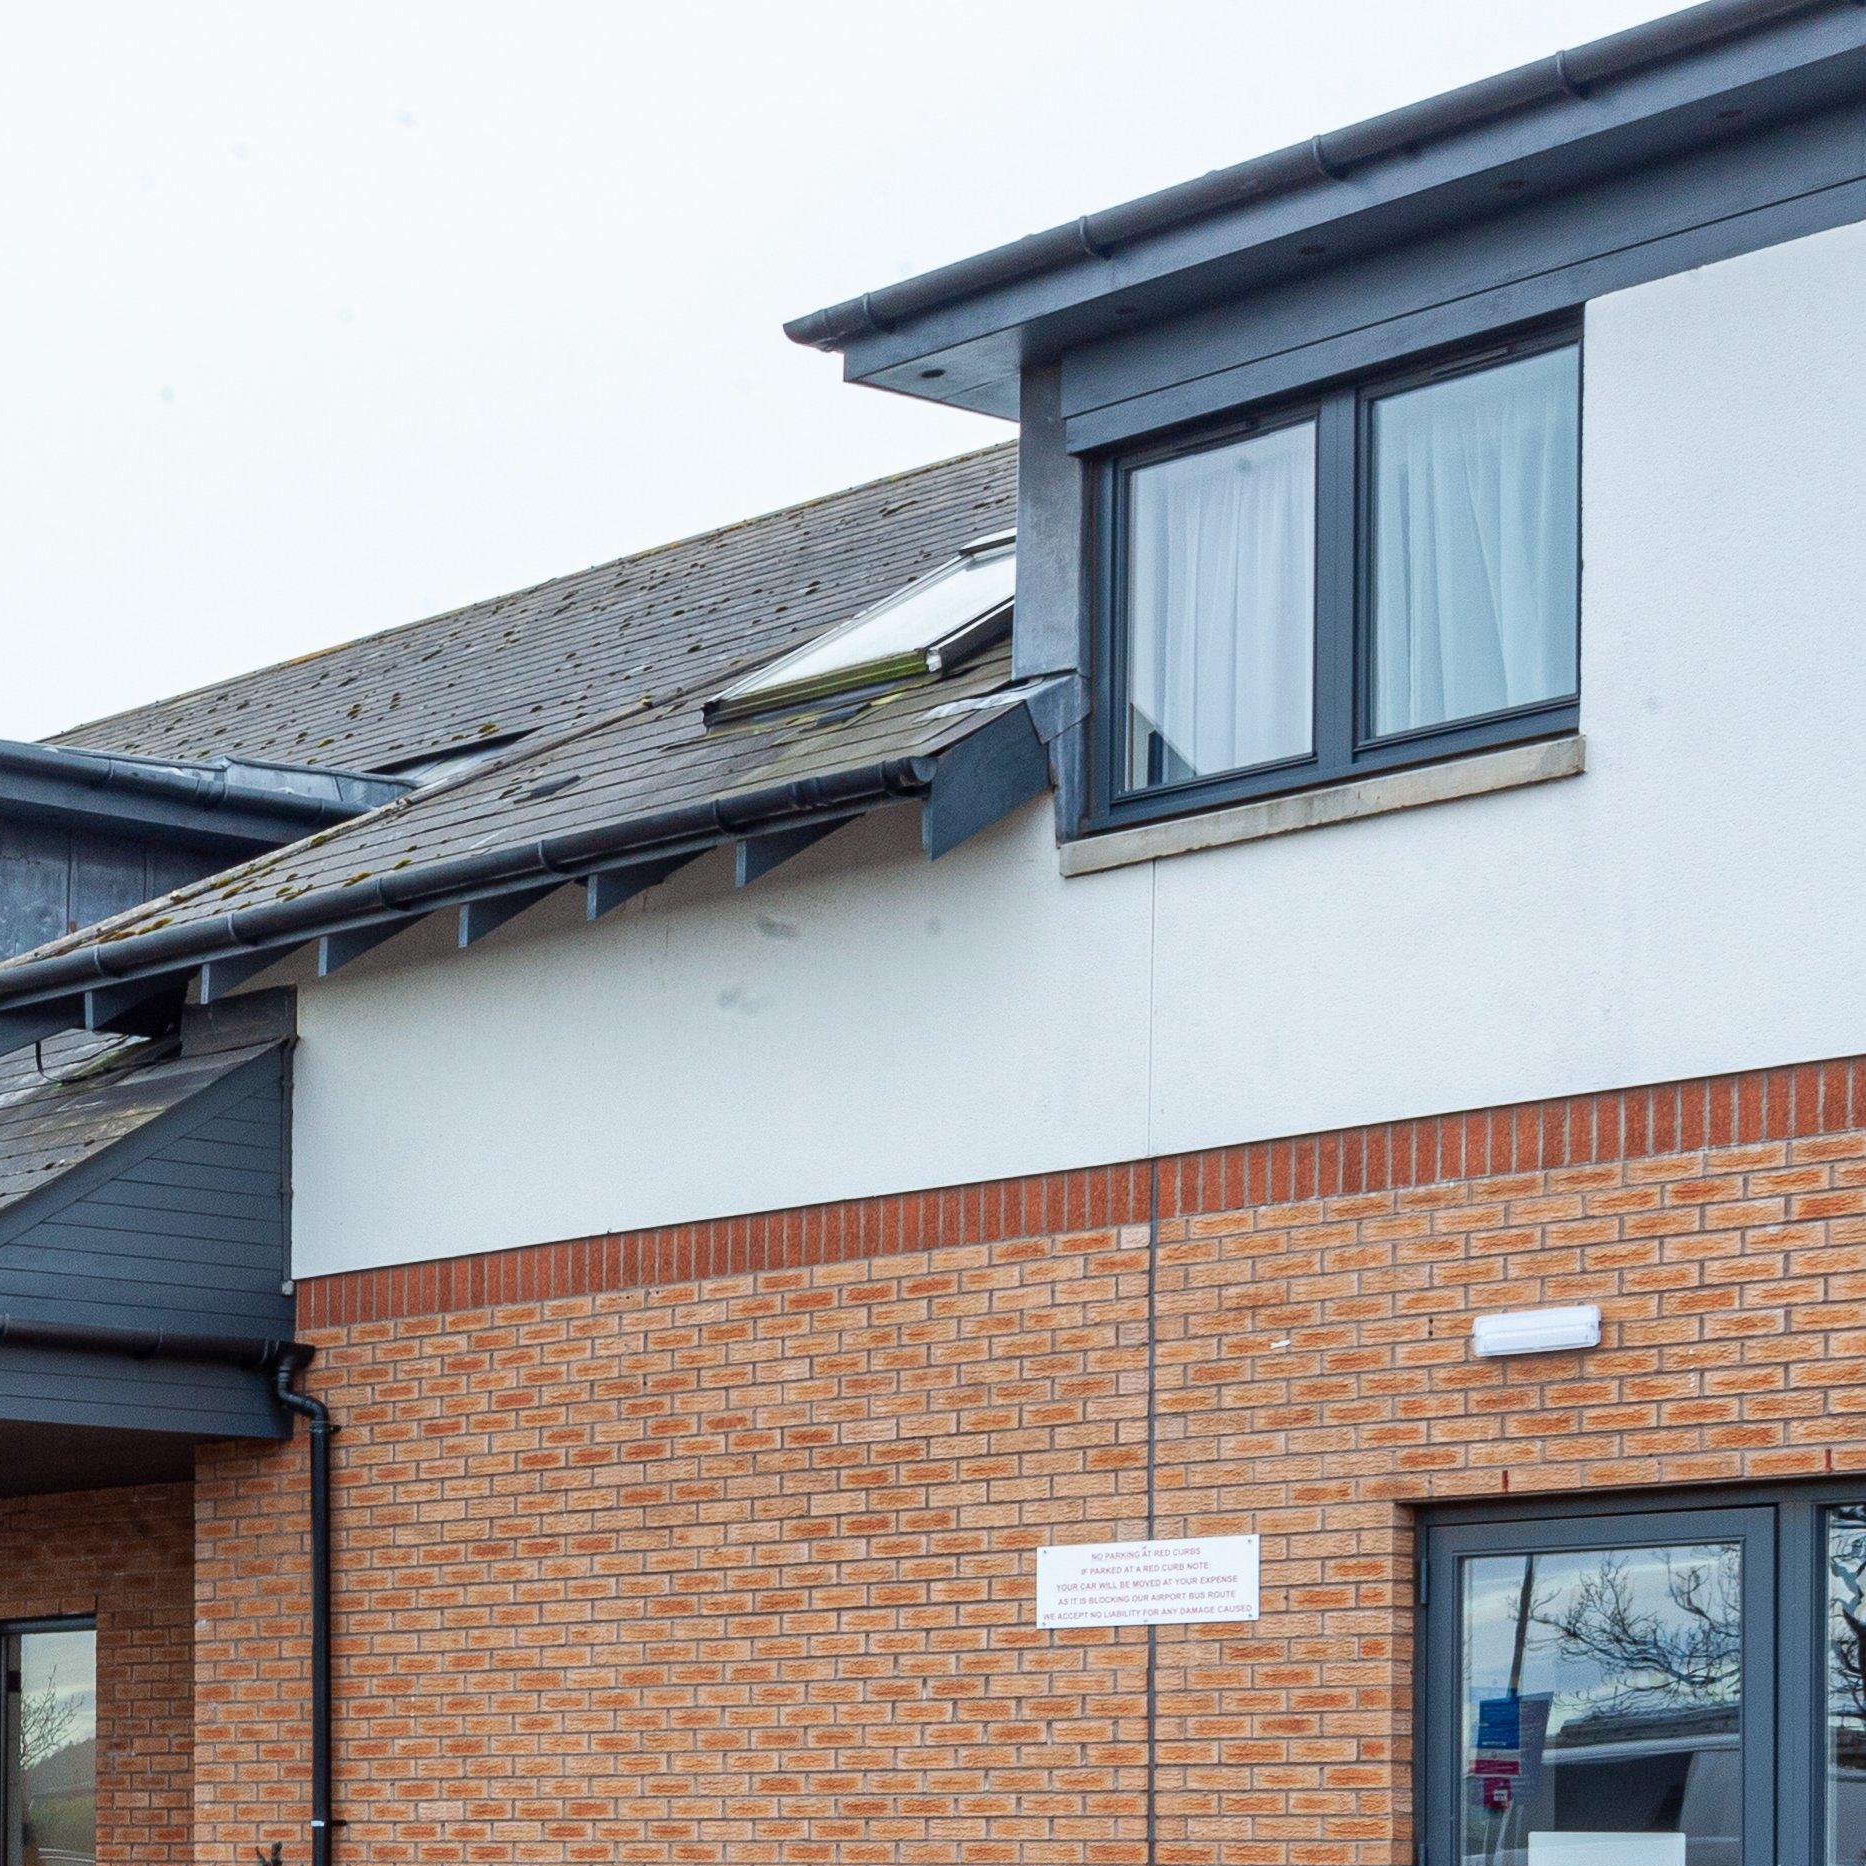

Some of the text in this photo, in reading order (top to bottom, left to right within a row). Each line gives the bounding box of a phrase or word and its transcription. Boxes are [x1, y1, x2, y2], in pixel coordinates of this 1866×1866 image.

[1105, 1551, 1141, 1560] PARKING
[1154, 1549, 1171, 1557] RED
[1172, 1547, 1202, 1556] CURBS
[1090, 1566, 1123, 1575] PARKED
[1124, 1565, 1134, 1573] AT
[1143, 1564, 1160, 1572] RED
[1162, 1563, 1185, 1571] CURB
[1056, 1583, 1078, 1592] YOUR
[1080, 1583, 1097, 1591] CAR
[1119, 1581, 1131, 1589] BE
[1133, 1579, 1161, 1588] MOVED
[1162, 1578, 1173, 1586] AT
[1174, 1577, 1199, 1585] YOUR
[1200, 1575, 1239, 1584] EXPENSE
[1058, 1598, 1068, 1606] AS
[1079, 1597, 1087, 1605] IS
[1088, 1595, 1129, 1605] BLOCKING
[1151, 1592, 1186, 1601] AIRPORT
[1188, 1591, 1206, 1599] BUS
[1207, 1590, 1236, 1598] ROUTE
[1057, 1612, 1089, 1620] ACCEPT
[1104, 1609, 1141, 1618] LIABILITY
[1142, 1608, 1159, 1616] FOR
[1161, 1607, 1178, 1615] ANY
[1179, 1606, 1214, 1615] DAMAGE
[1217, 1604, 1252, 1613] CAUSED
